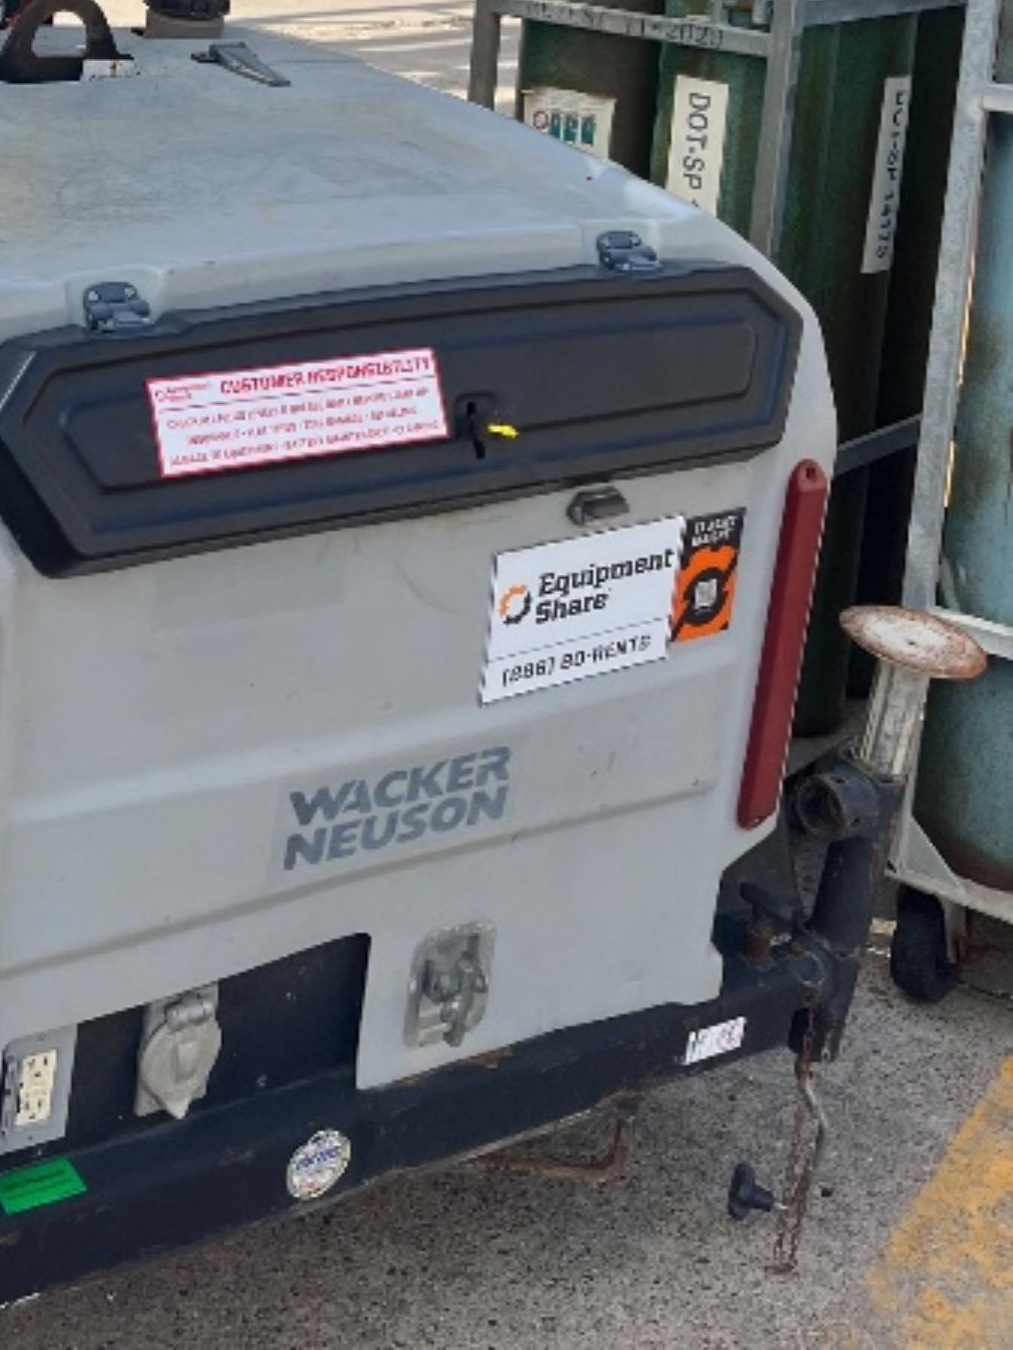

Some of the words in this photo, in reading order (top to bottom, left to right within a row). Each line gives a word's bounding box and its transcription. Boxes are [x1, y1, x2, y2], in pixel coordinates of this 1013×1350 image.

[682, 92, 711, 190] DOT-SP
[535, 592, 608, 625] Share
[537, 548, 675, 597] Equipment
[289, 745, 511, 826] WACKER
[283, 785, 510, 871] NEUSON
